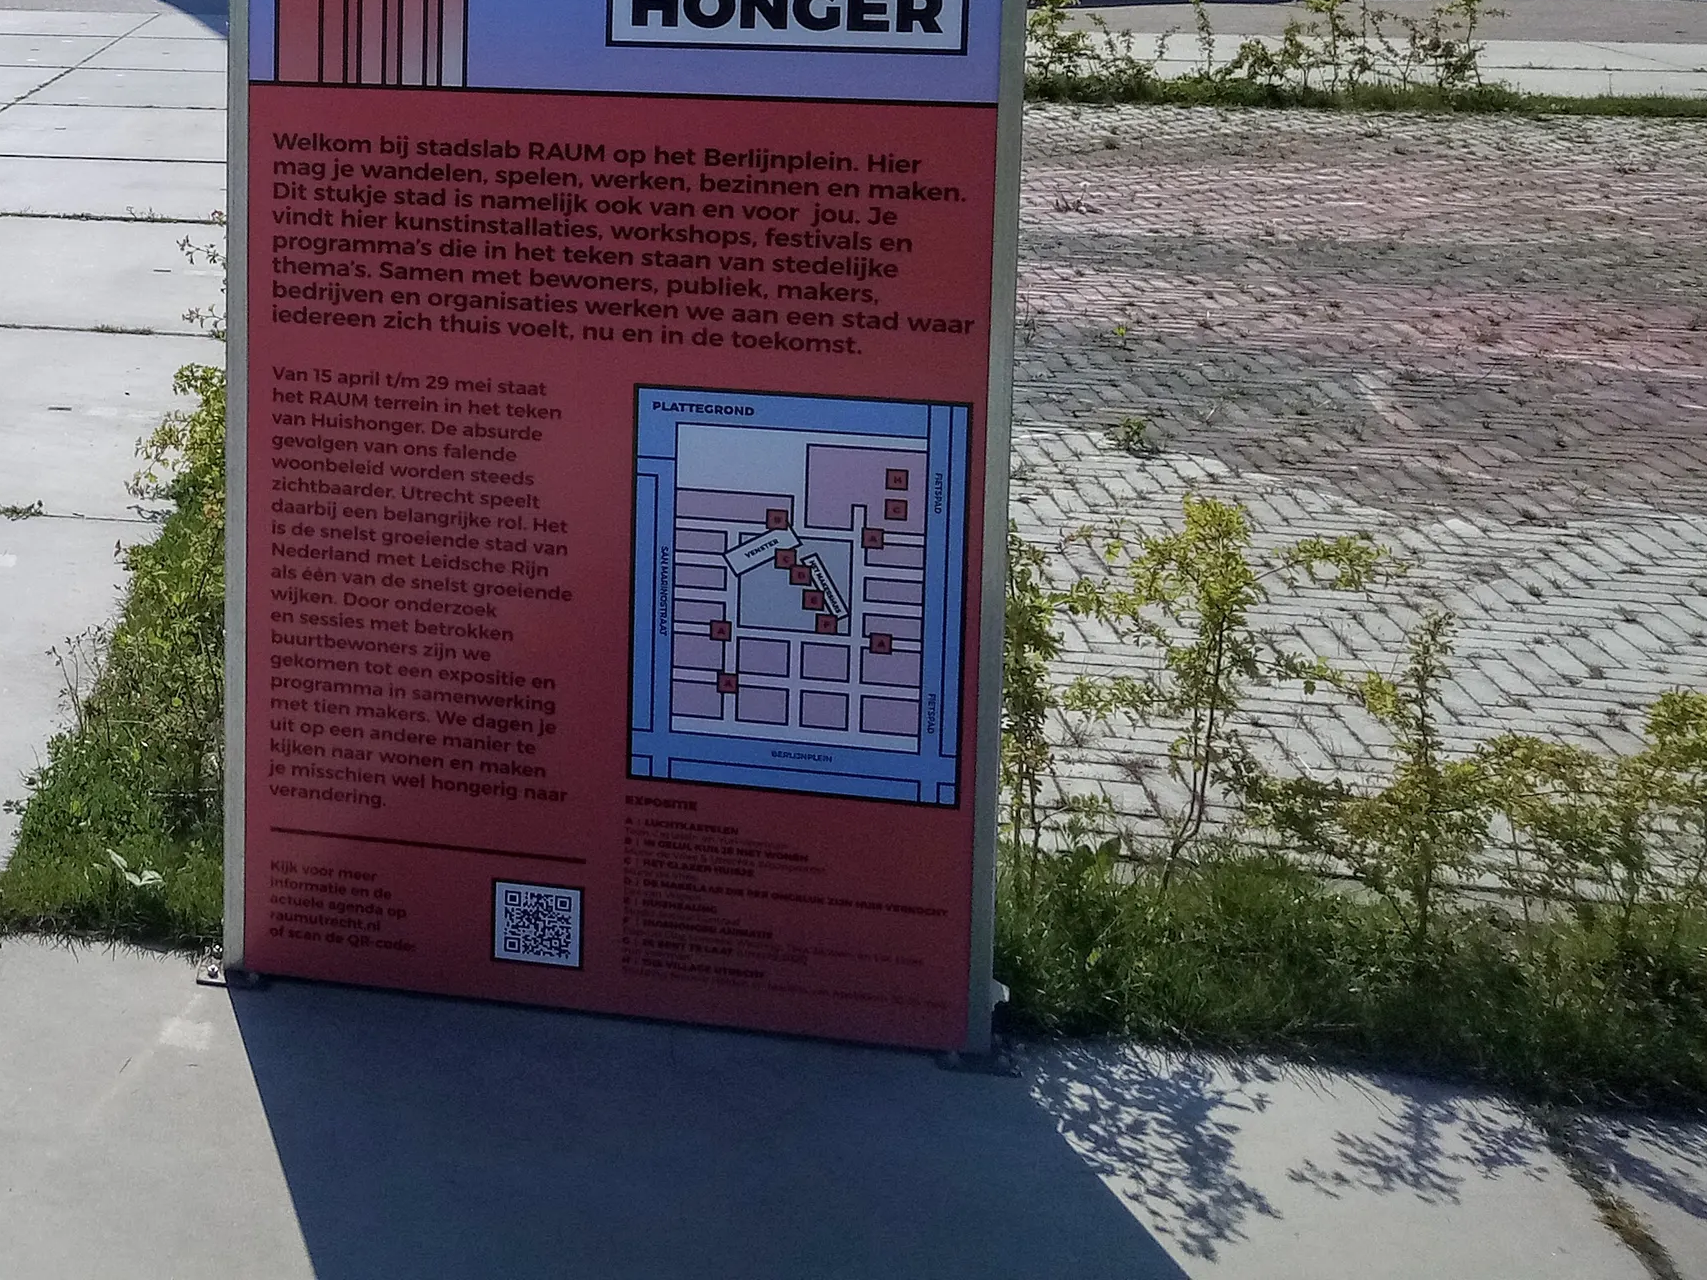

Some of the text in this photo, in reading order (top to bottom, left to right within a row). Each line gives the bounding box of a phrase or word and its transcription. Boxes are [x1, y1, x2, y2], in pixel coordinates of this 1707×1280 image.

[272, 132, 922, 174] Welkom bij stadslab RAUM op het Berlijnplein. Hier
[273, 157, 966, 202] mag je wandelen, spelen, werken, bezinnen en maken.
[272, 180, 898, 227] Dit stukje stad is namelijk ook van en voor jou. Je
[271, 205, 912, 252] vindt hier kunstinstallaties, workshops, festivals en
[272, 235, 899, 281] programma's die in het teken staan van stedelijke
[271, 255, 879, 305] thema's. Samen met bewoners, publiek, makers,
[272, 279, 975, 334] bedrijven en organisaties werken we aan een stad waar
[271, 303, 862, 354] iedereen zich thuis voelt, nu en in de toekomst.
[272, 365, 546, 396] Van 15 april t/m 29 mei staat
[272, 387, 561, 419] het RAUM terrein in het teken
[652, 400, 755, 417] PLATTEGROND
[271, 413, 542, 441] van Huishonger. De absurde
[271, 434, 517, 462] gevolgen van ons falende
[271, 457, 534, 486] woonbeleid worden steeds
[271, 476, 540, 509] zichtbaarder. Utrecht speelt
[271, 498, 567, 533] daarbij een belangrijke rol. Het
[271, 542, 548, 579] Nederland met Leidsche Rijn
[743, 538, 779, 559] VENSTER
[270, 586, 497, 617] wijken. Door onderzoek
[270, 676, 555, 715] programma in samenwerking
[268, 759, 568, 802] je misschien wel hongerig naar
[269, 784, 386, 809] verandering.
